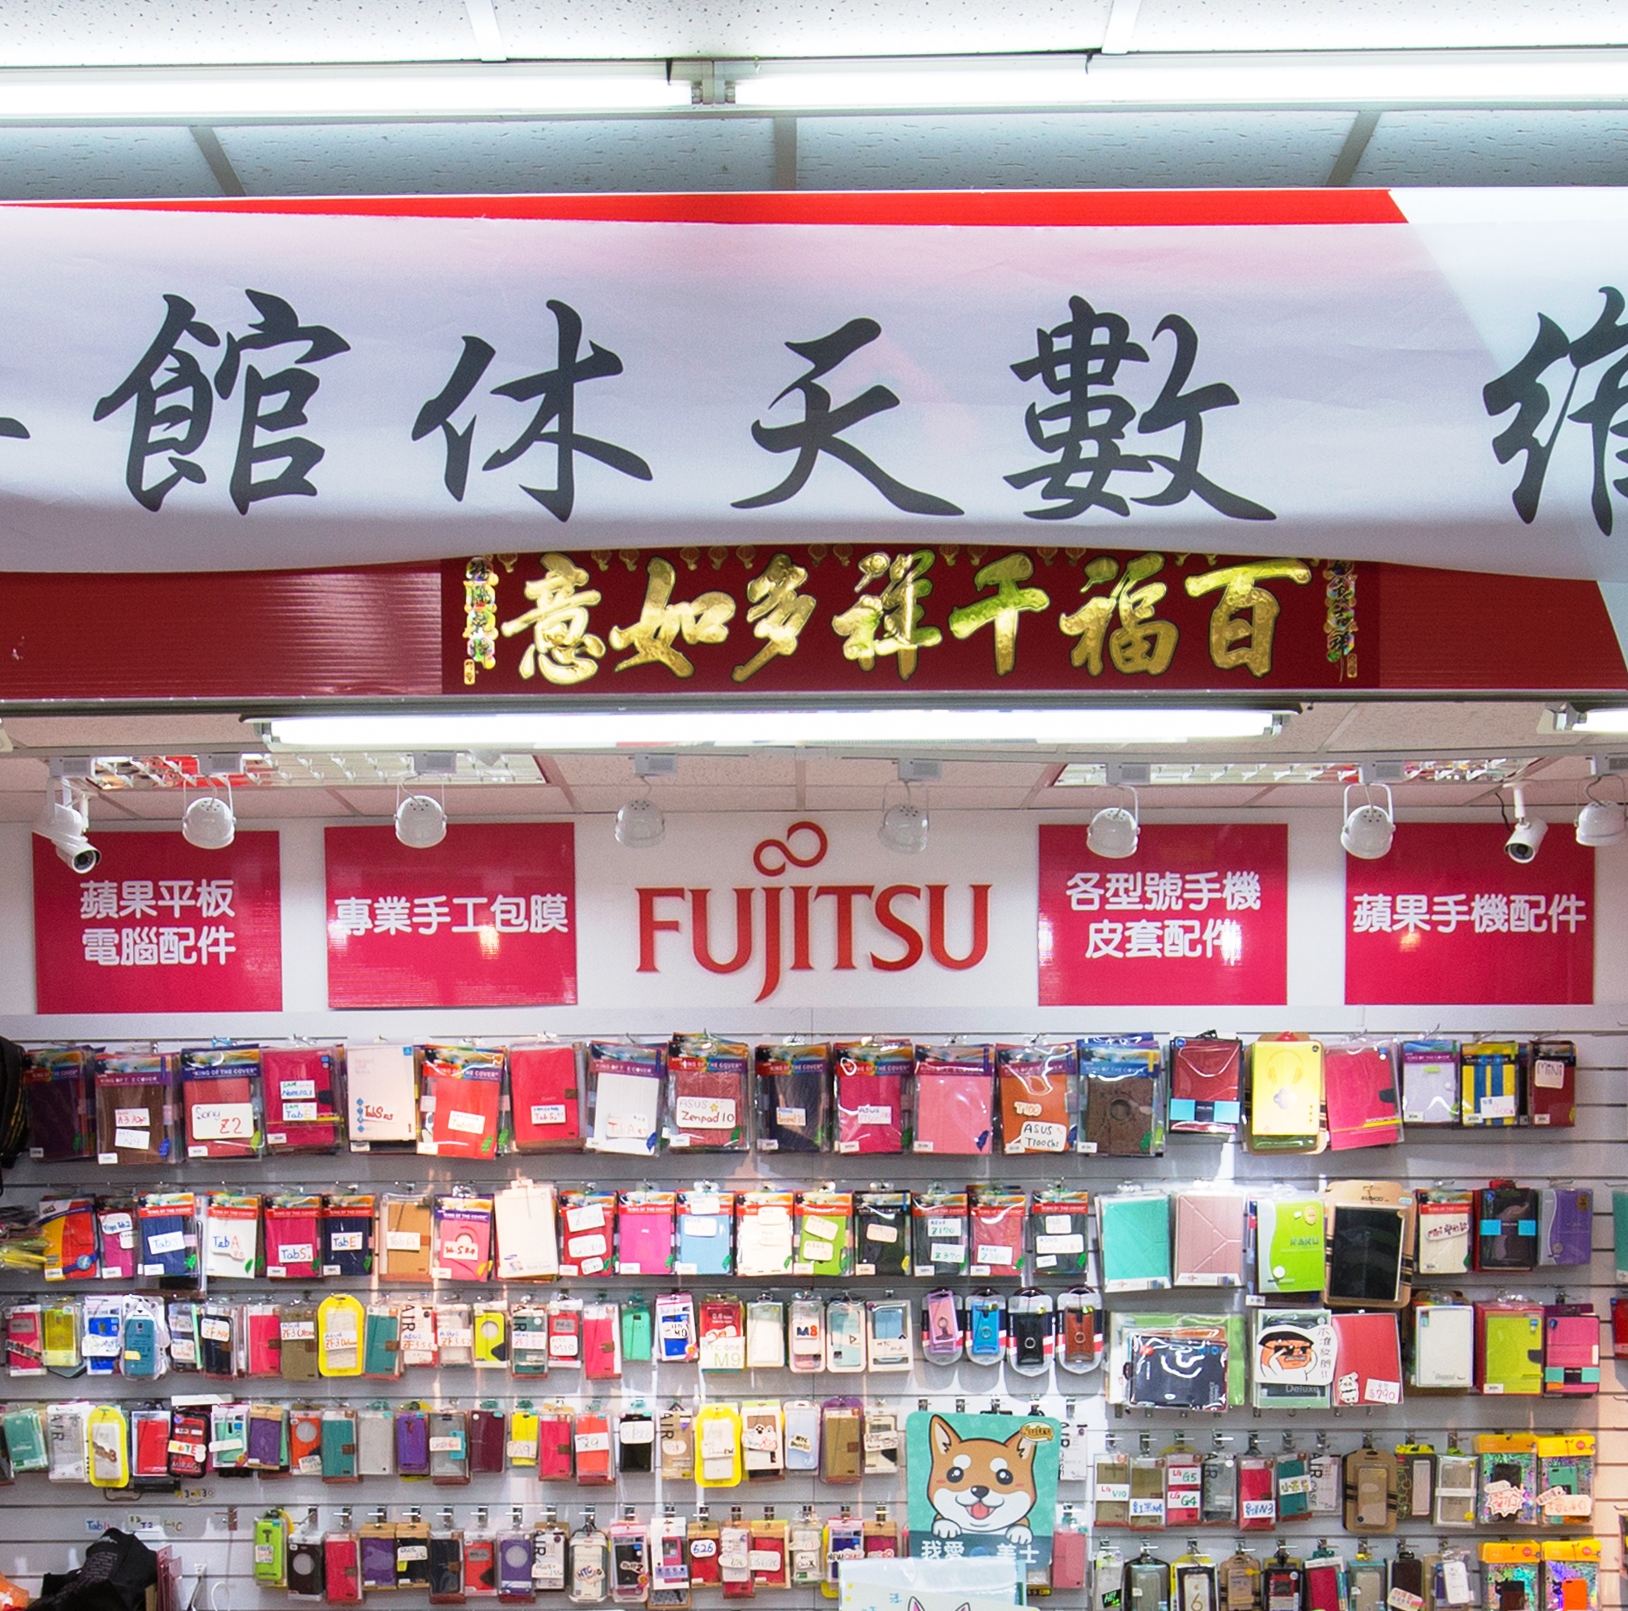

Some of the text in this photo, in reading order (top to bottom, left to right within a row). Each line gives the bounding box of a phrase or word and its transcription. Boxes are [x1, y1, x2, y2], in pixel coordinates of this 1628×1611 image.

[1066, 870, 1262, 912] 各型號手機
[80, 879, 236, 919] 蘋果平板
[334, 892, 570, 935] 專業手工包膜
[1352, 892, 1588, 935] 蘋果手機配件
[82, 924, 237, 968] 電腦配件
[635, 882, 991, 1003] FUJITSU
[1085, 918, 1242, 961] 皮套配件
[681, 1110, 735, 1125] Zenpad 10
[219, 1117, 243, 1135] Z2
[1023, 1124, 1053, 1136] ASUS
[796, 1324, 819, 1337] M8
[714, 1354, 741, 1368] M9
[1368, 1388, 1397, 1401] $790
[1181, 1472, 1198, 1483] G5
[1111, 1490, 1127, 1498] V10
[1180, 1495, 1198, 1507] G4
[693, 1543, 714, 1554] 626
